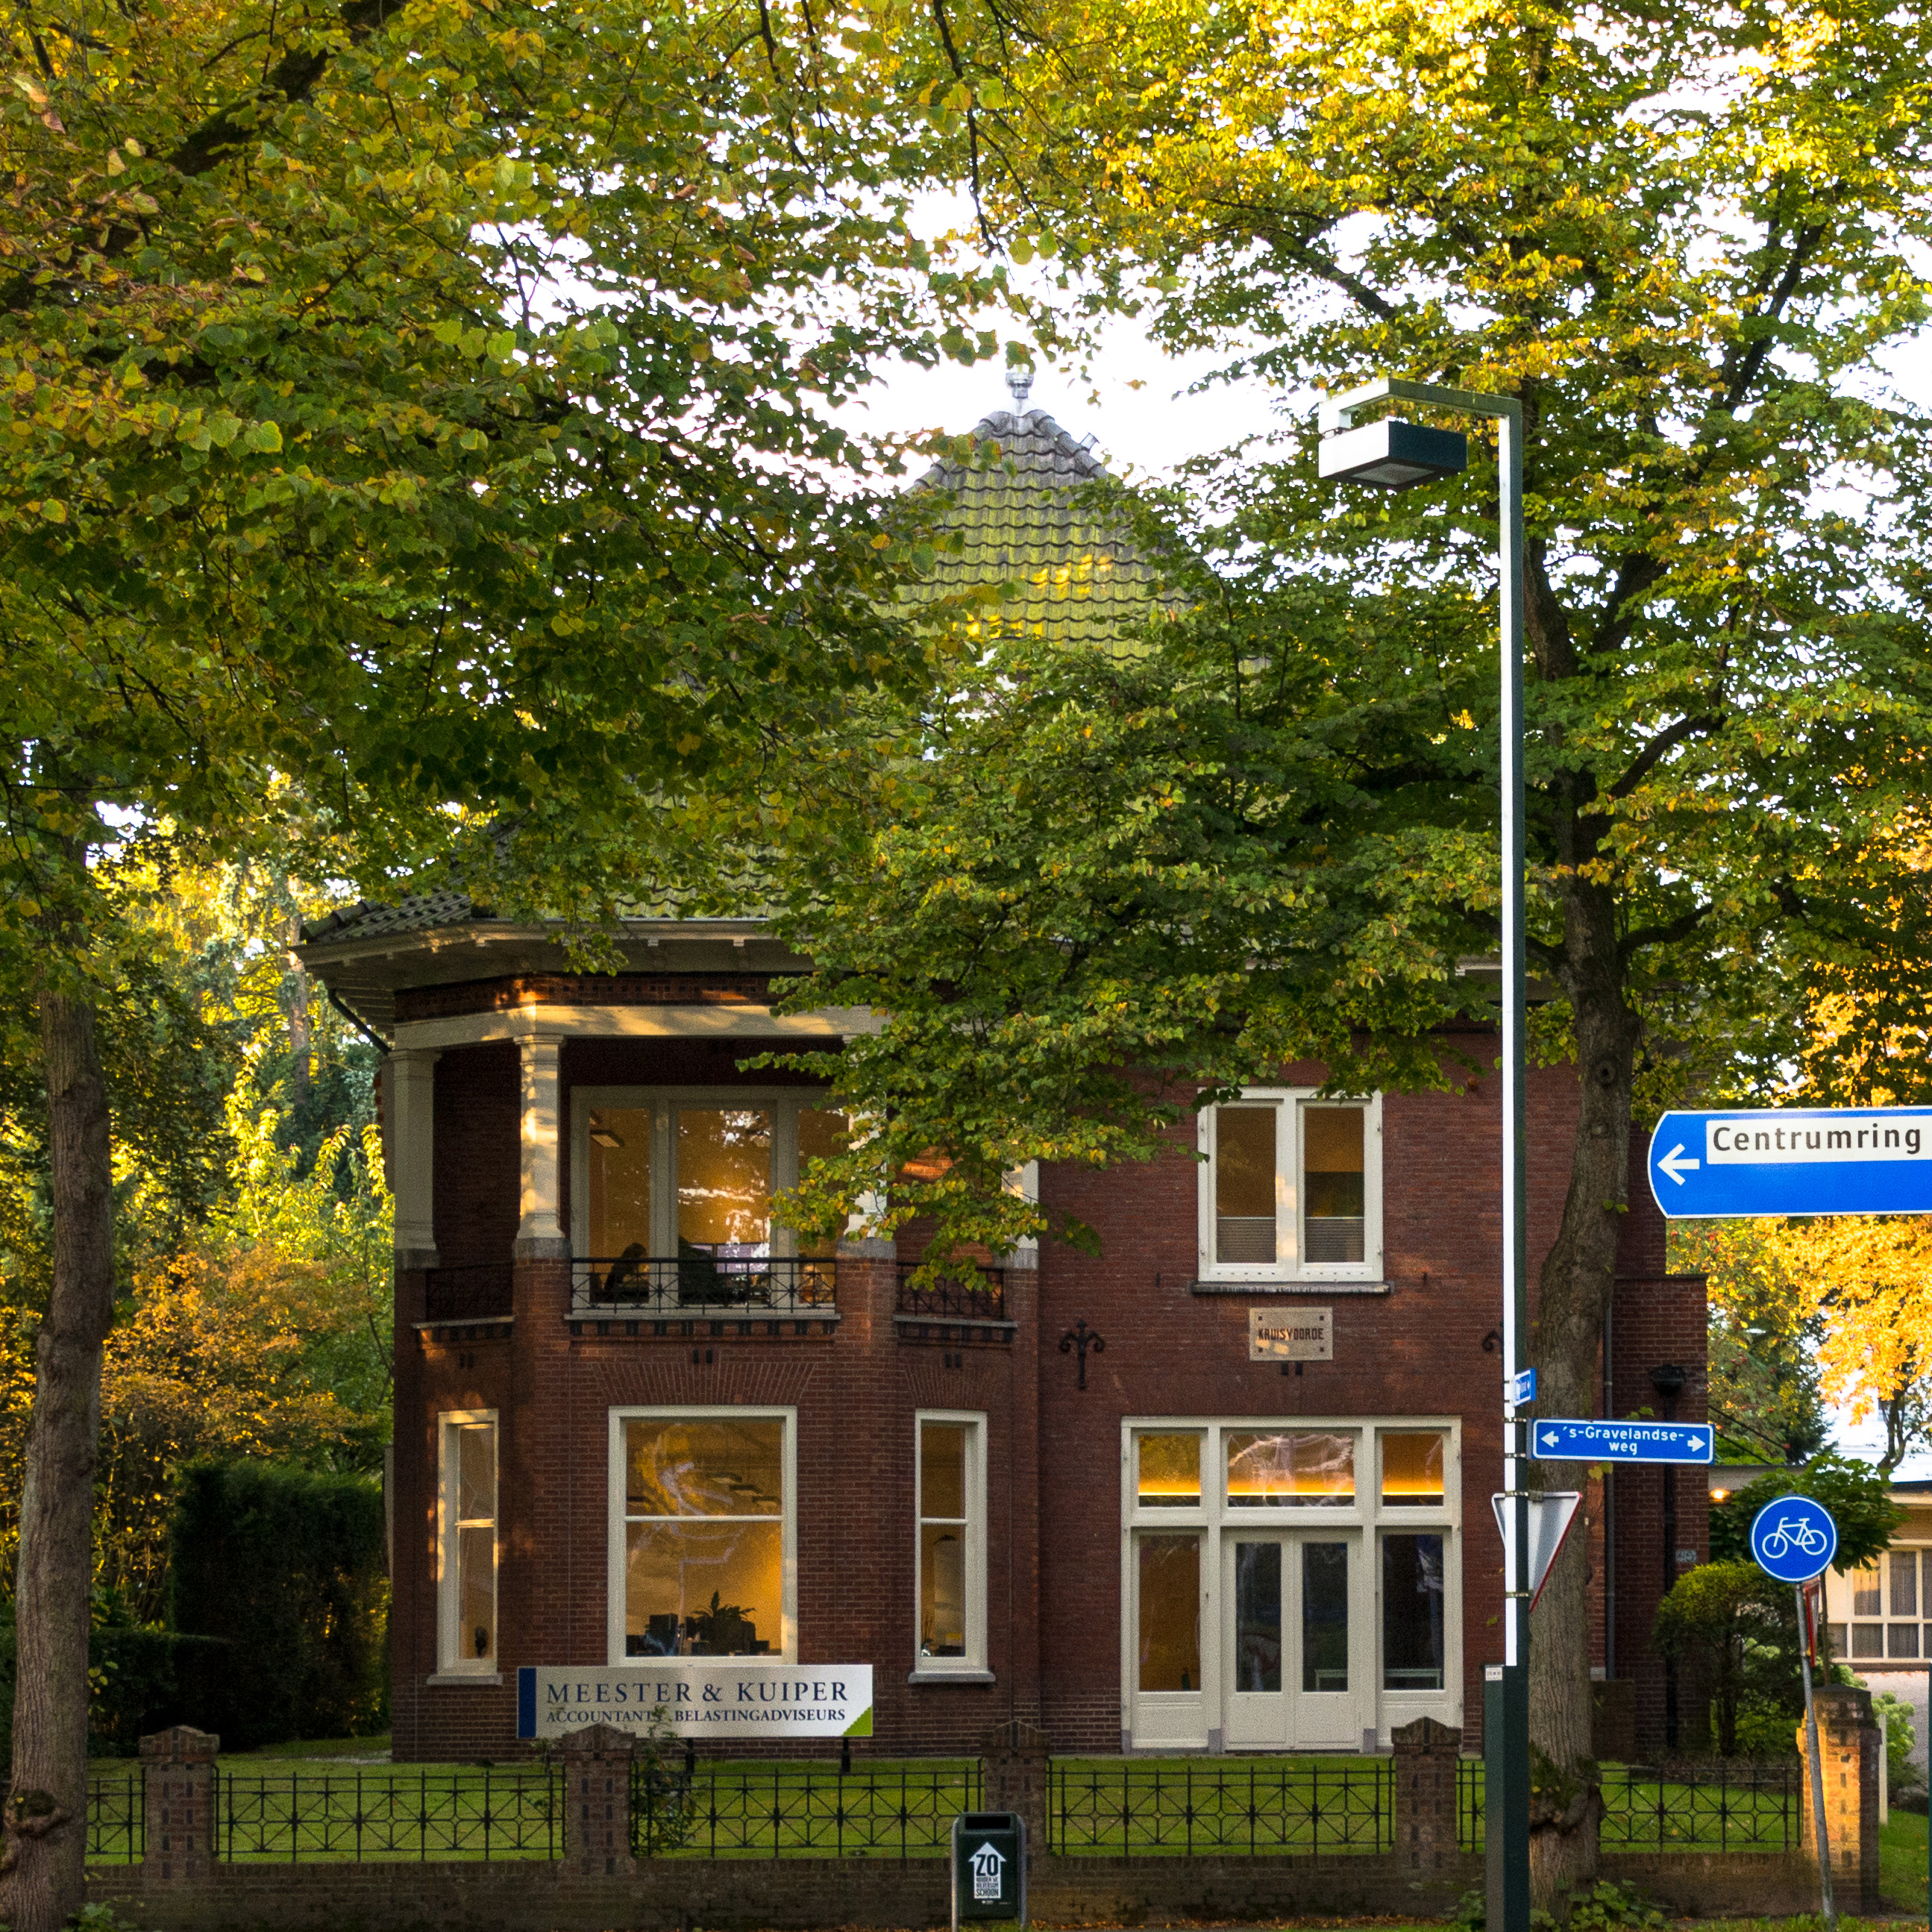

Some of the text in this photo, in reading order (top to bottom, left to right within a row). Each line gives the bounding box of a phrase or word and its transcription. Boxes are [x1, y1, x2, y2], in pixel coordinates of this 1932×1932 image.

[1713, 1123, 1921, 1155] Centrumring
[1609, 1442, 1637, 1456] weg
[546, 1681, 849, 1703] MEESTER & KUIPER
[675, 1708, 846, 1722] BELASTINGADVISEURS
[976, 1854, 999, 1876] ZO
